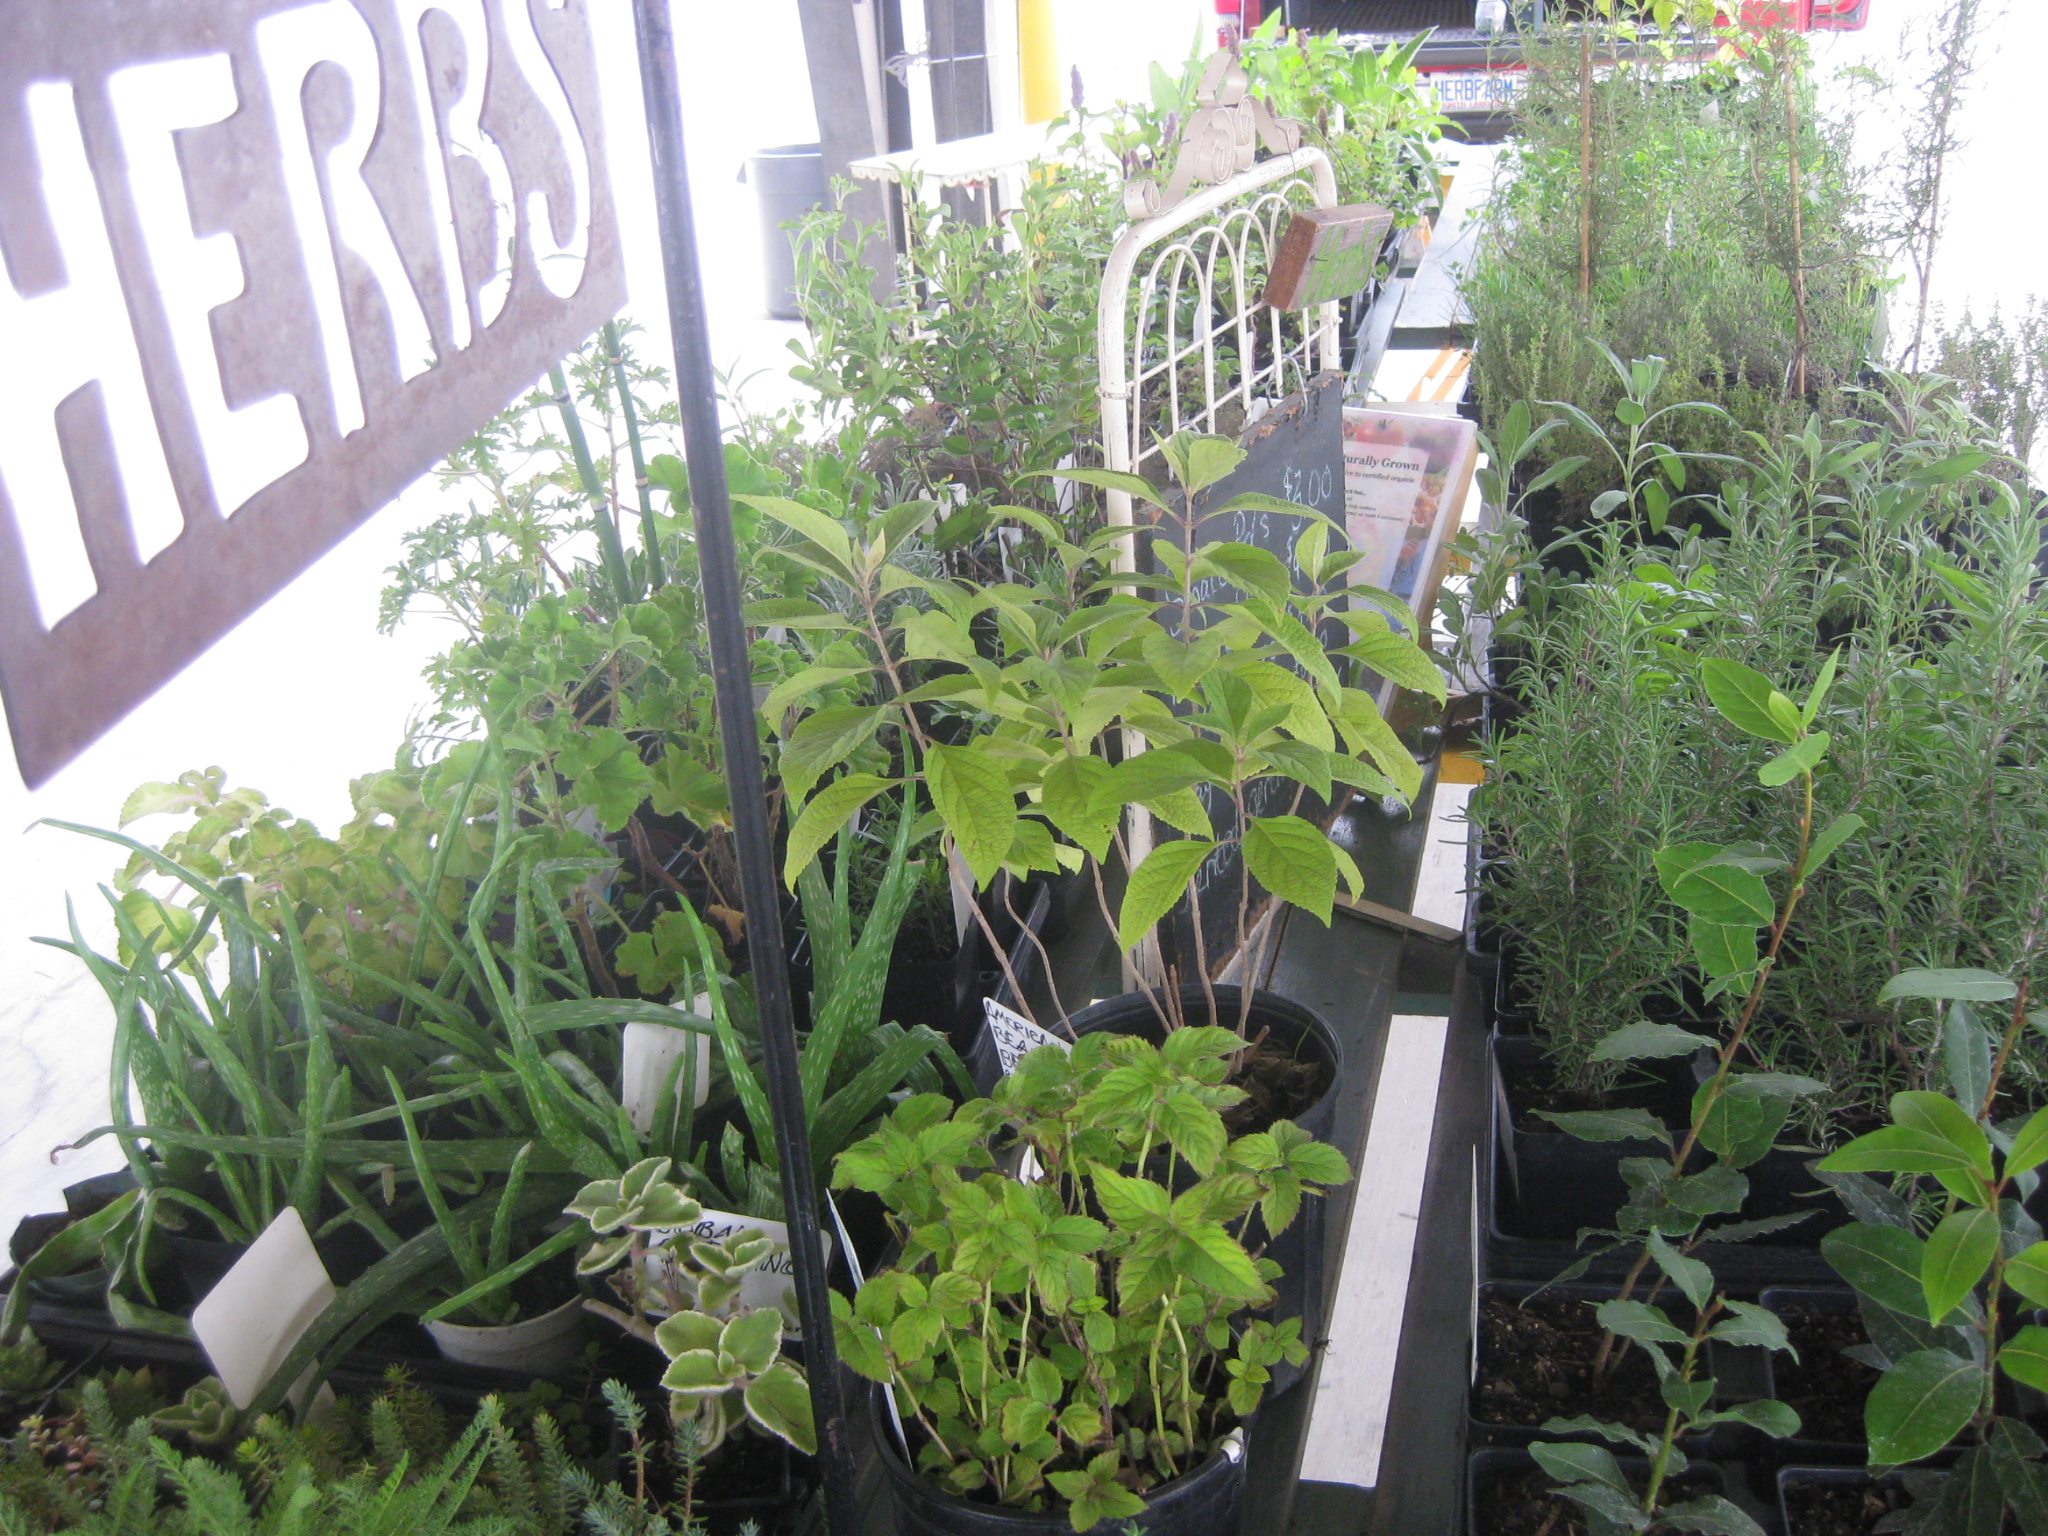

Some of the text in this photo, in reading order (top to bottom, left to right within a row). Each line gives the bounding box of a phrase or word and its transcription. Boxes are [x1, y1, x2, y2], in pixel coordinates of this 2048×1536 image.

[1435, 79, 1514, 101] HERBFARM
[0, 0, 592, 632] HERBS
[1381, 457, 1420, 471] Grown
[985, 1000, 1062, 1047] AMERICA
